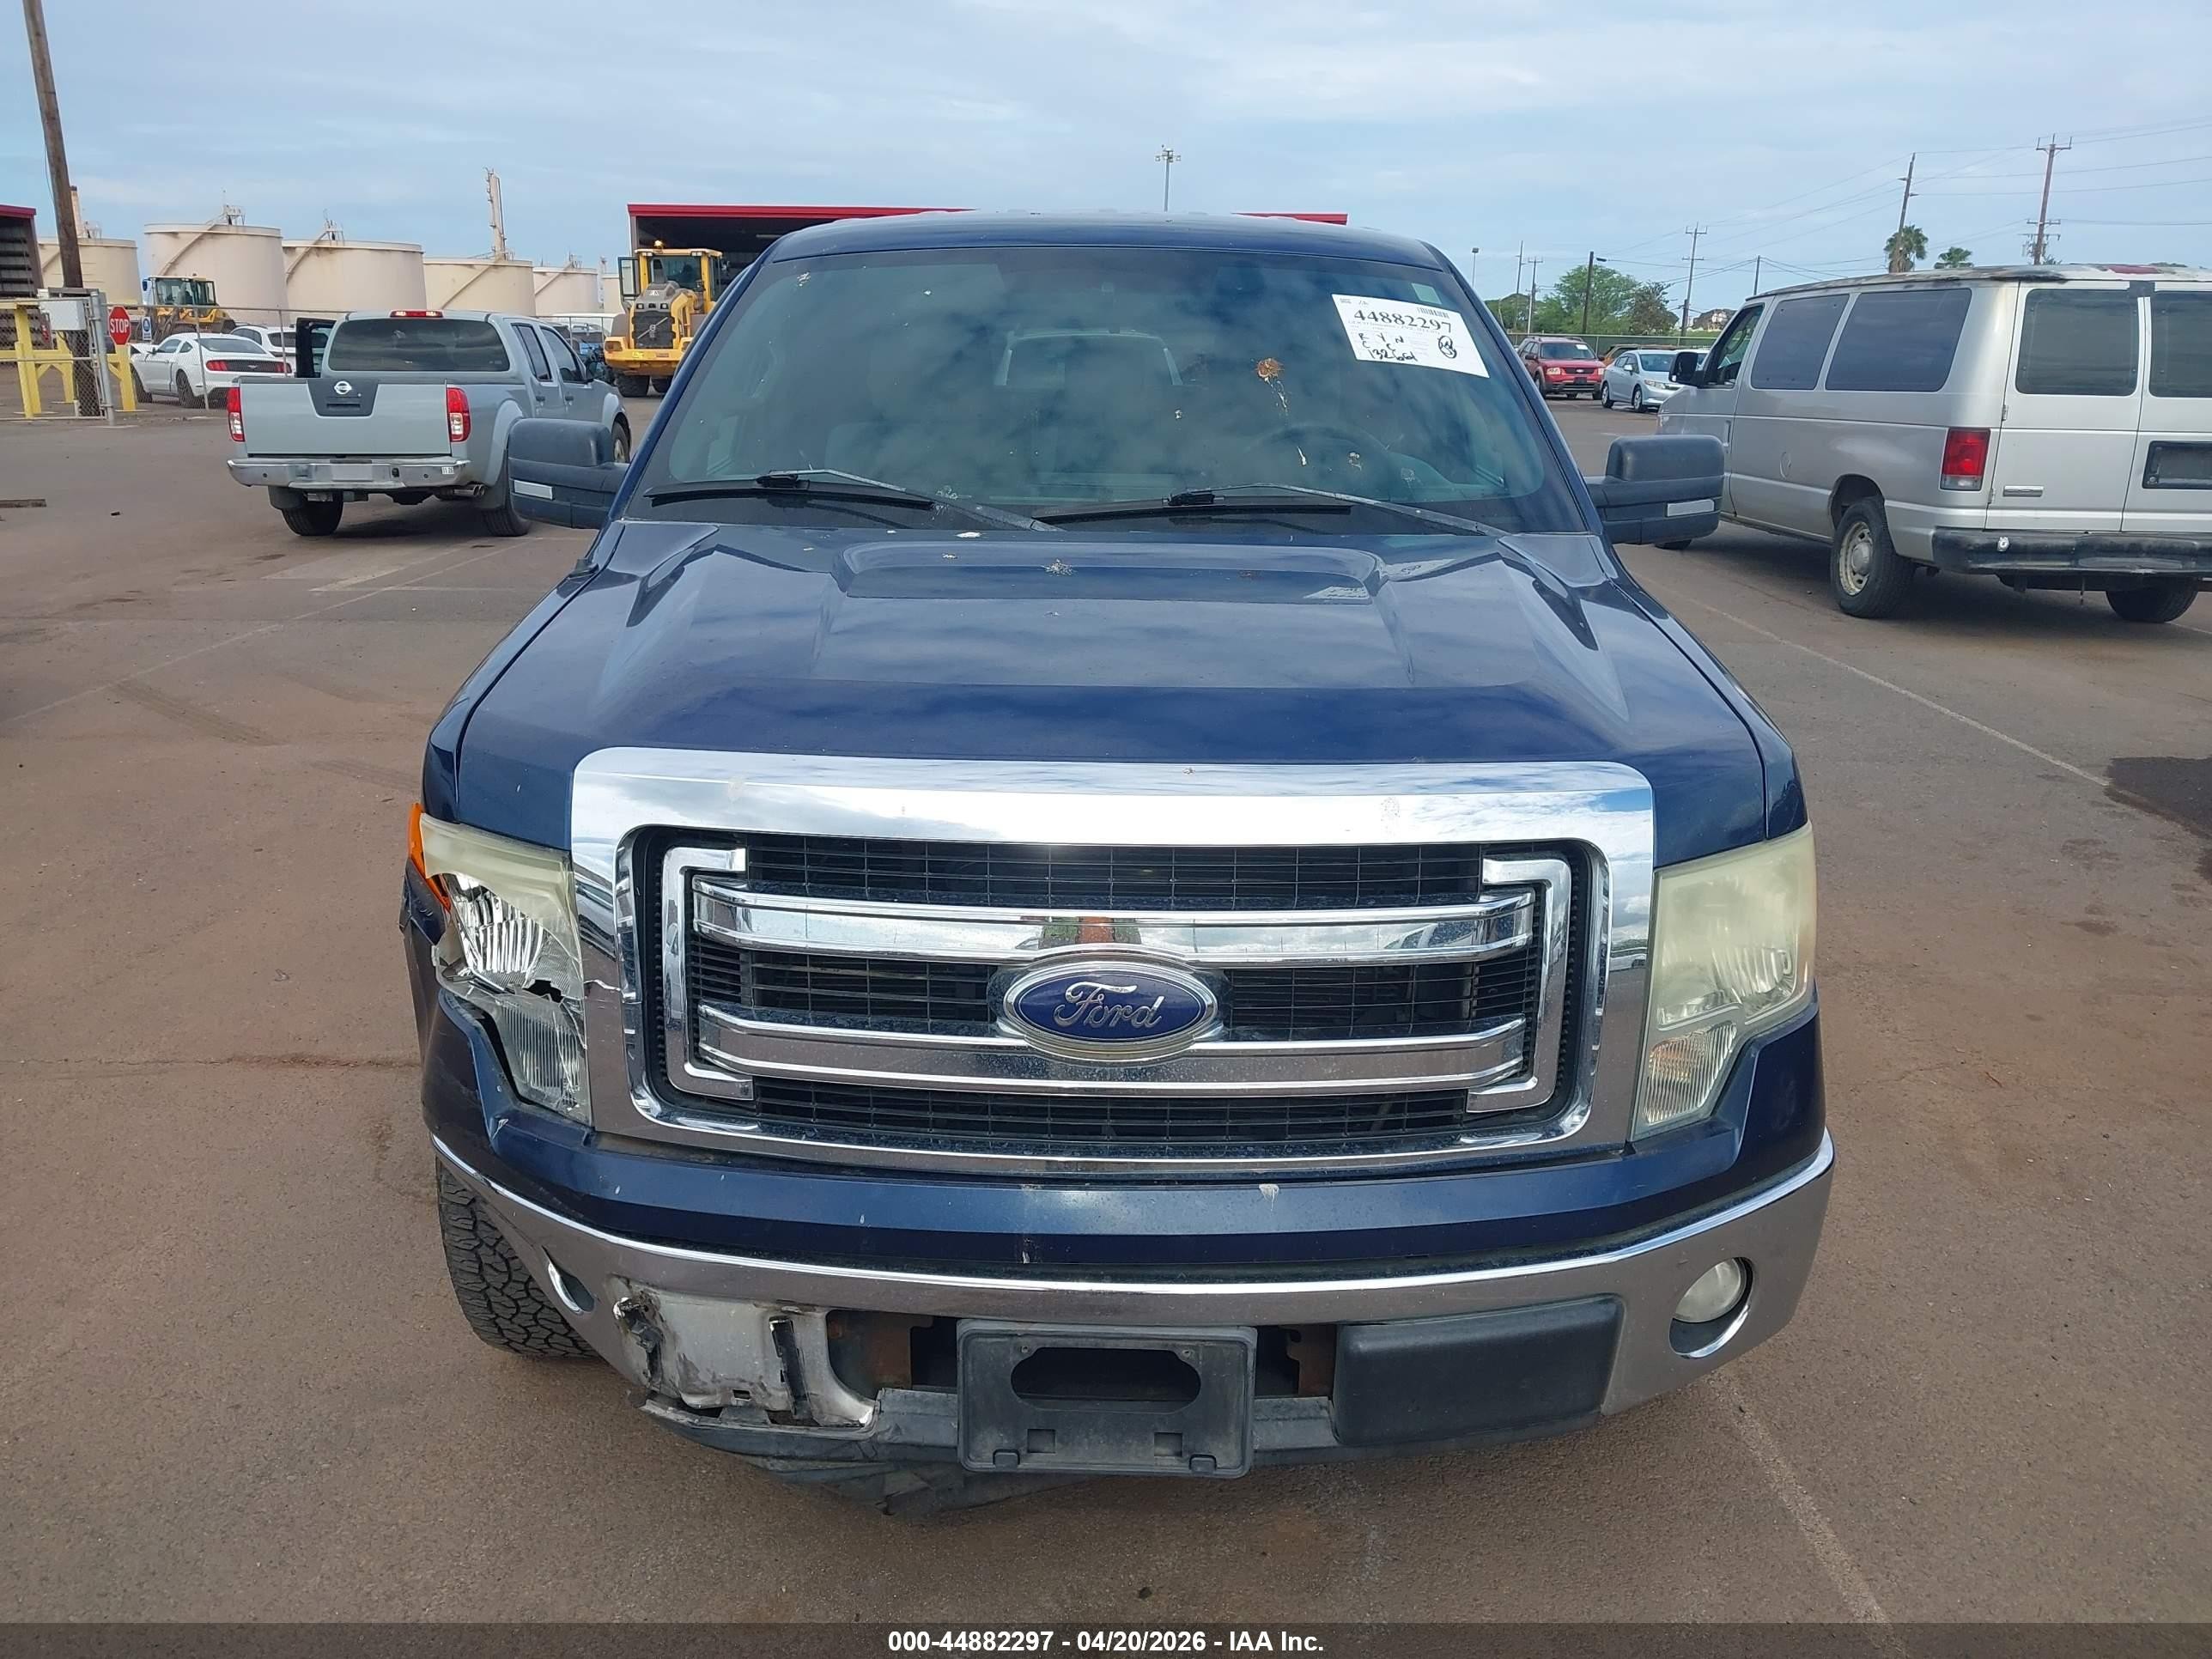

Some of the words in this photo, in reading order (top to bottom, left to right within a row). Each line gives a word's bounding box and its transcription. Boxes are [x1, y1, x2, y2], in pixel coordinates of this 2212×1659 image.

[110, 319, 129, 333] STOP
[1354, 309, 1451, 333] 44882297
[1053, 981, 1165, 1029] Ford
